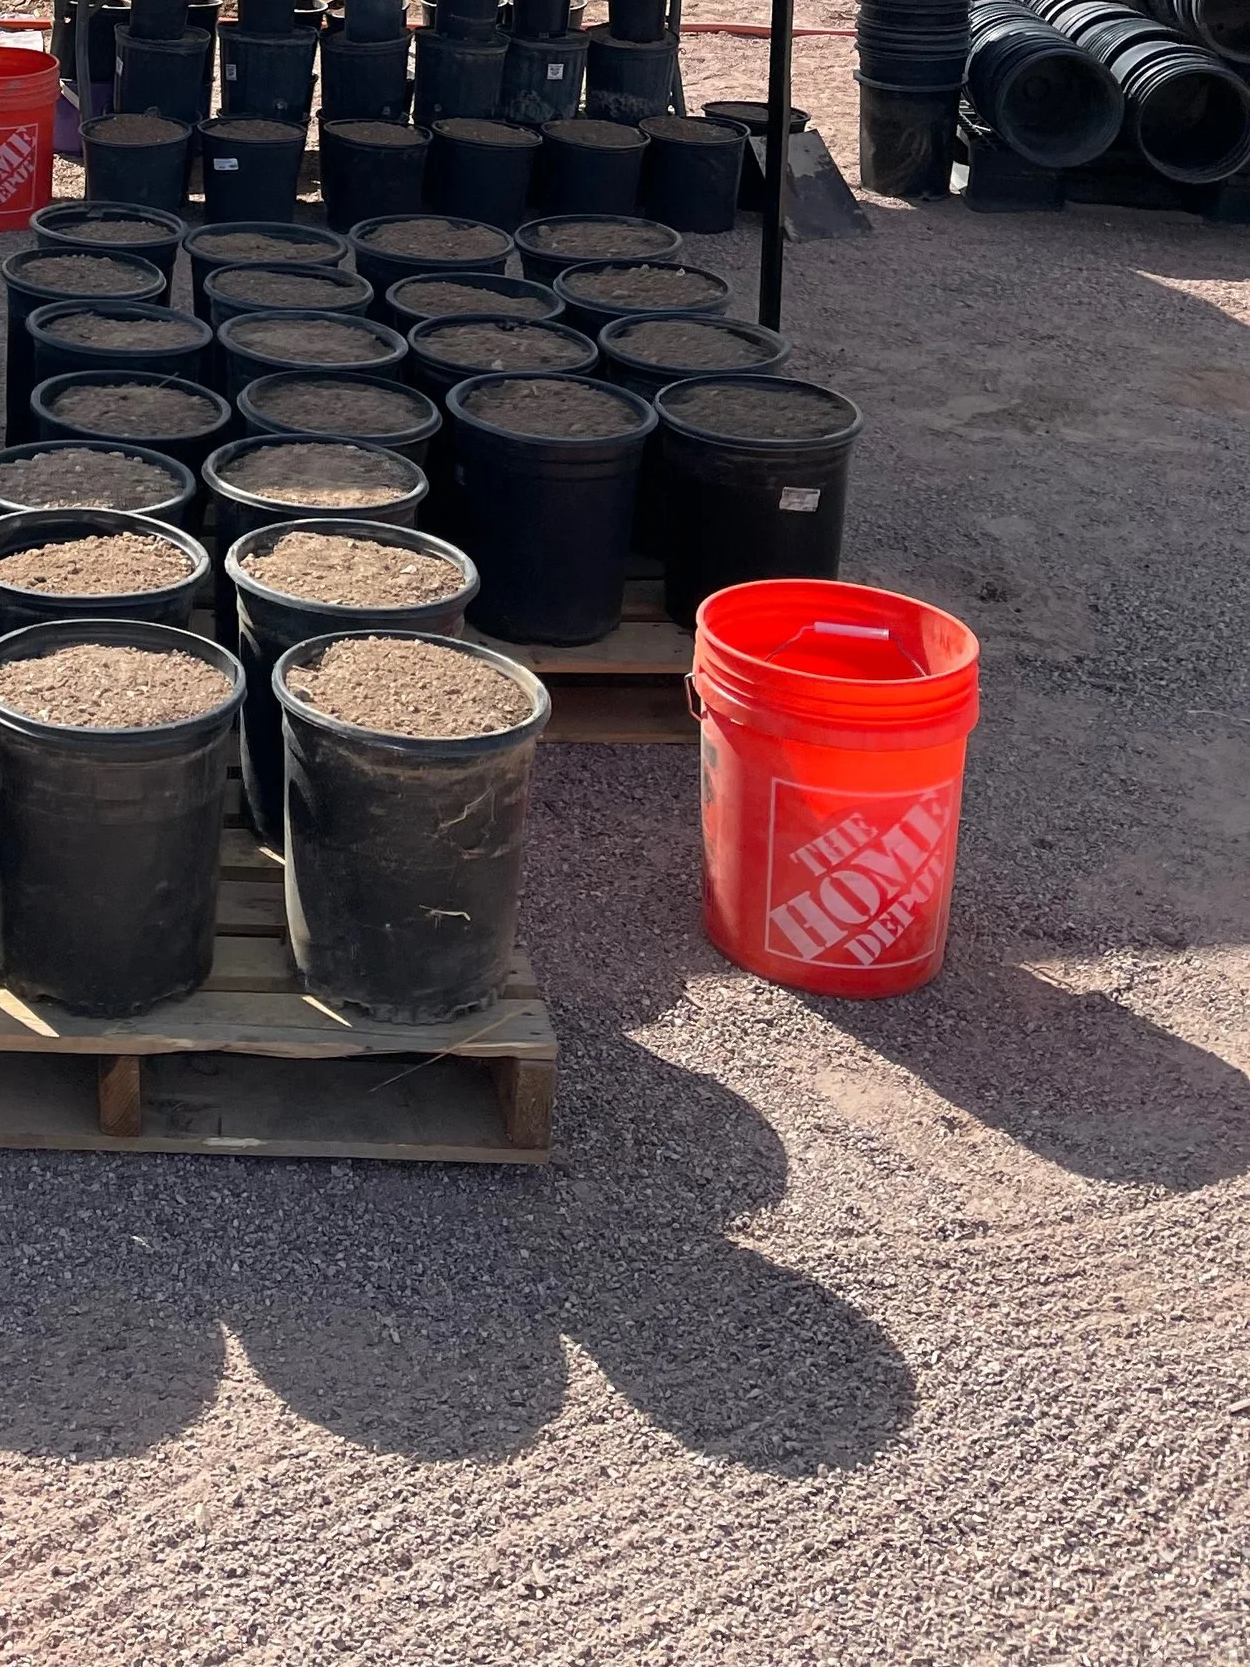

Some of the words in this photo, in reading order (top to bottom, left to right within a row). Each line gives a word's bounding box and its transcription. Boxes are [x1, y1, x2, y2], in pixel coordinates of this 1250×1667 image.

[768, 793, 953, 962] HOME
[789, 812, 879, 877] THE
[843, 849, 947, 967] DEPOT
